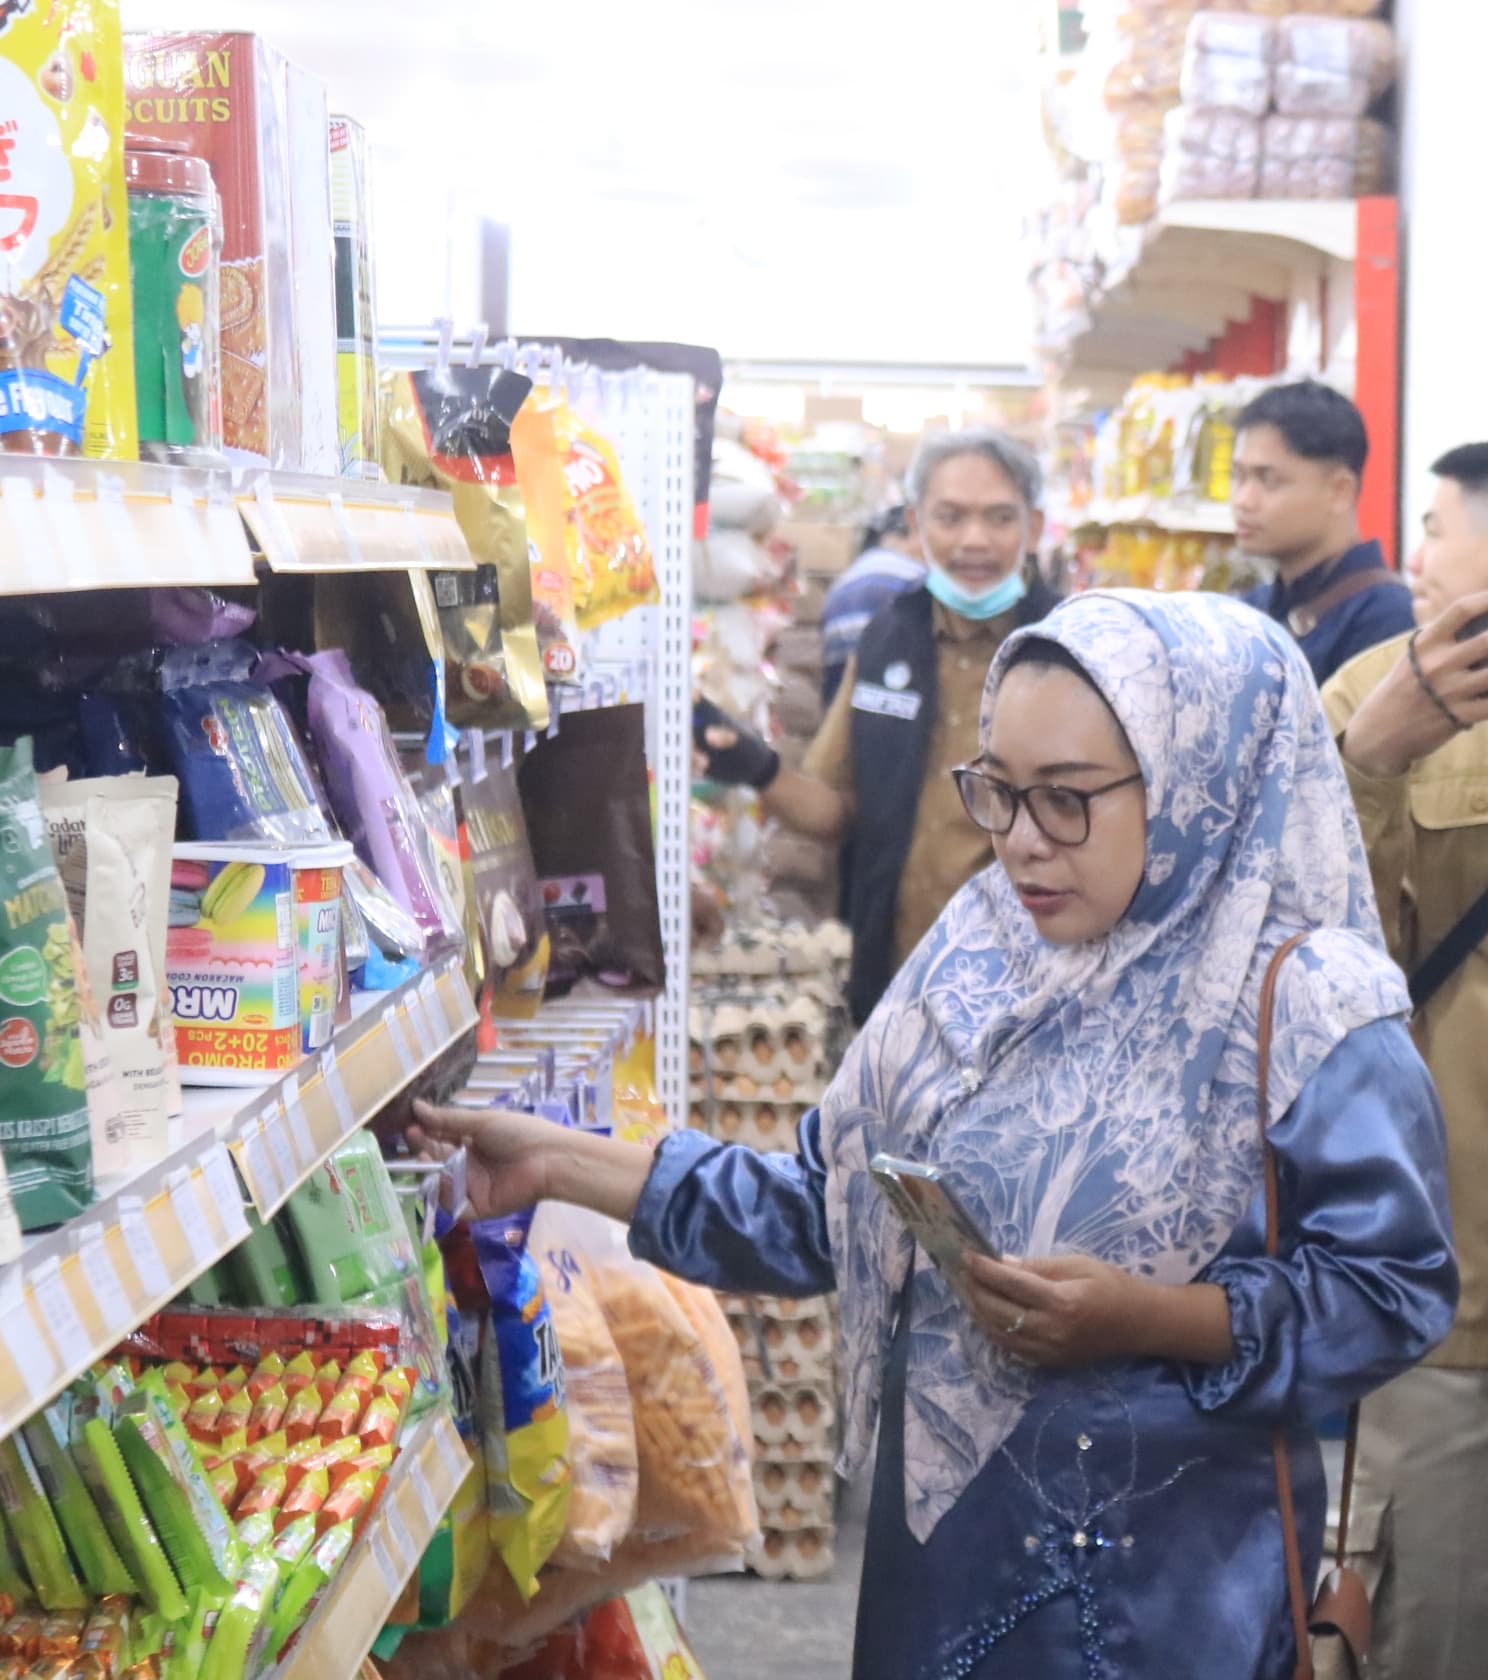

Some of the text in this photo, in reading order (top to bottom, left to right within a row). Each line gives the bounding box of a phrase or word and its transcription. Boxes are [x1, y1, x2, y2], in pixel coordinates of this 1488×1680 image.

[193, 973, 245, 983] MACARON
[214, 1031, 268, 1053] 20+2
[188, 1051, 266, 1069] PROMO
